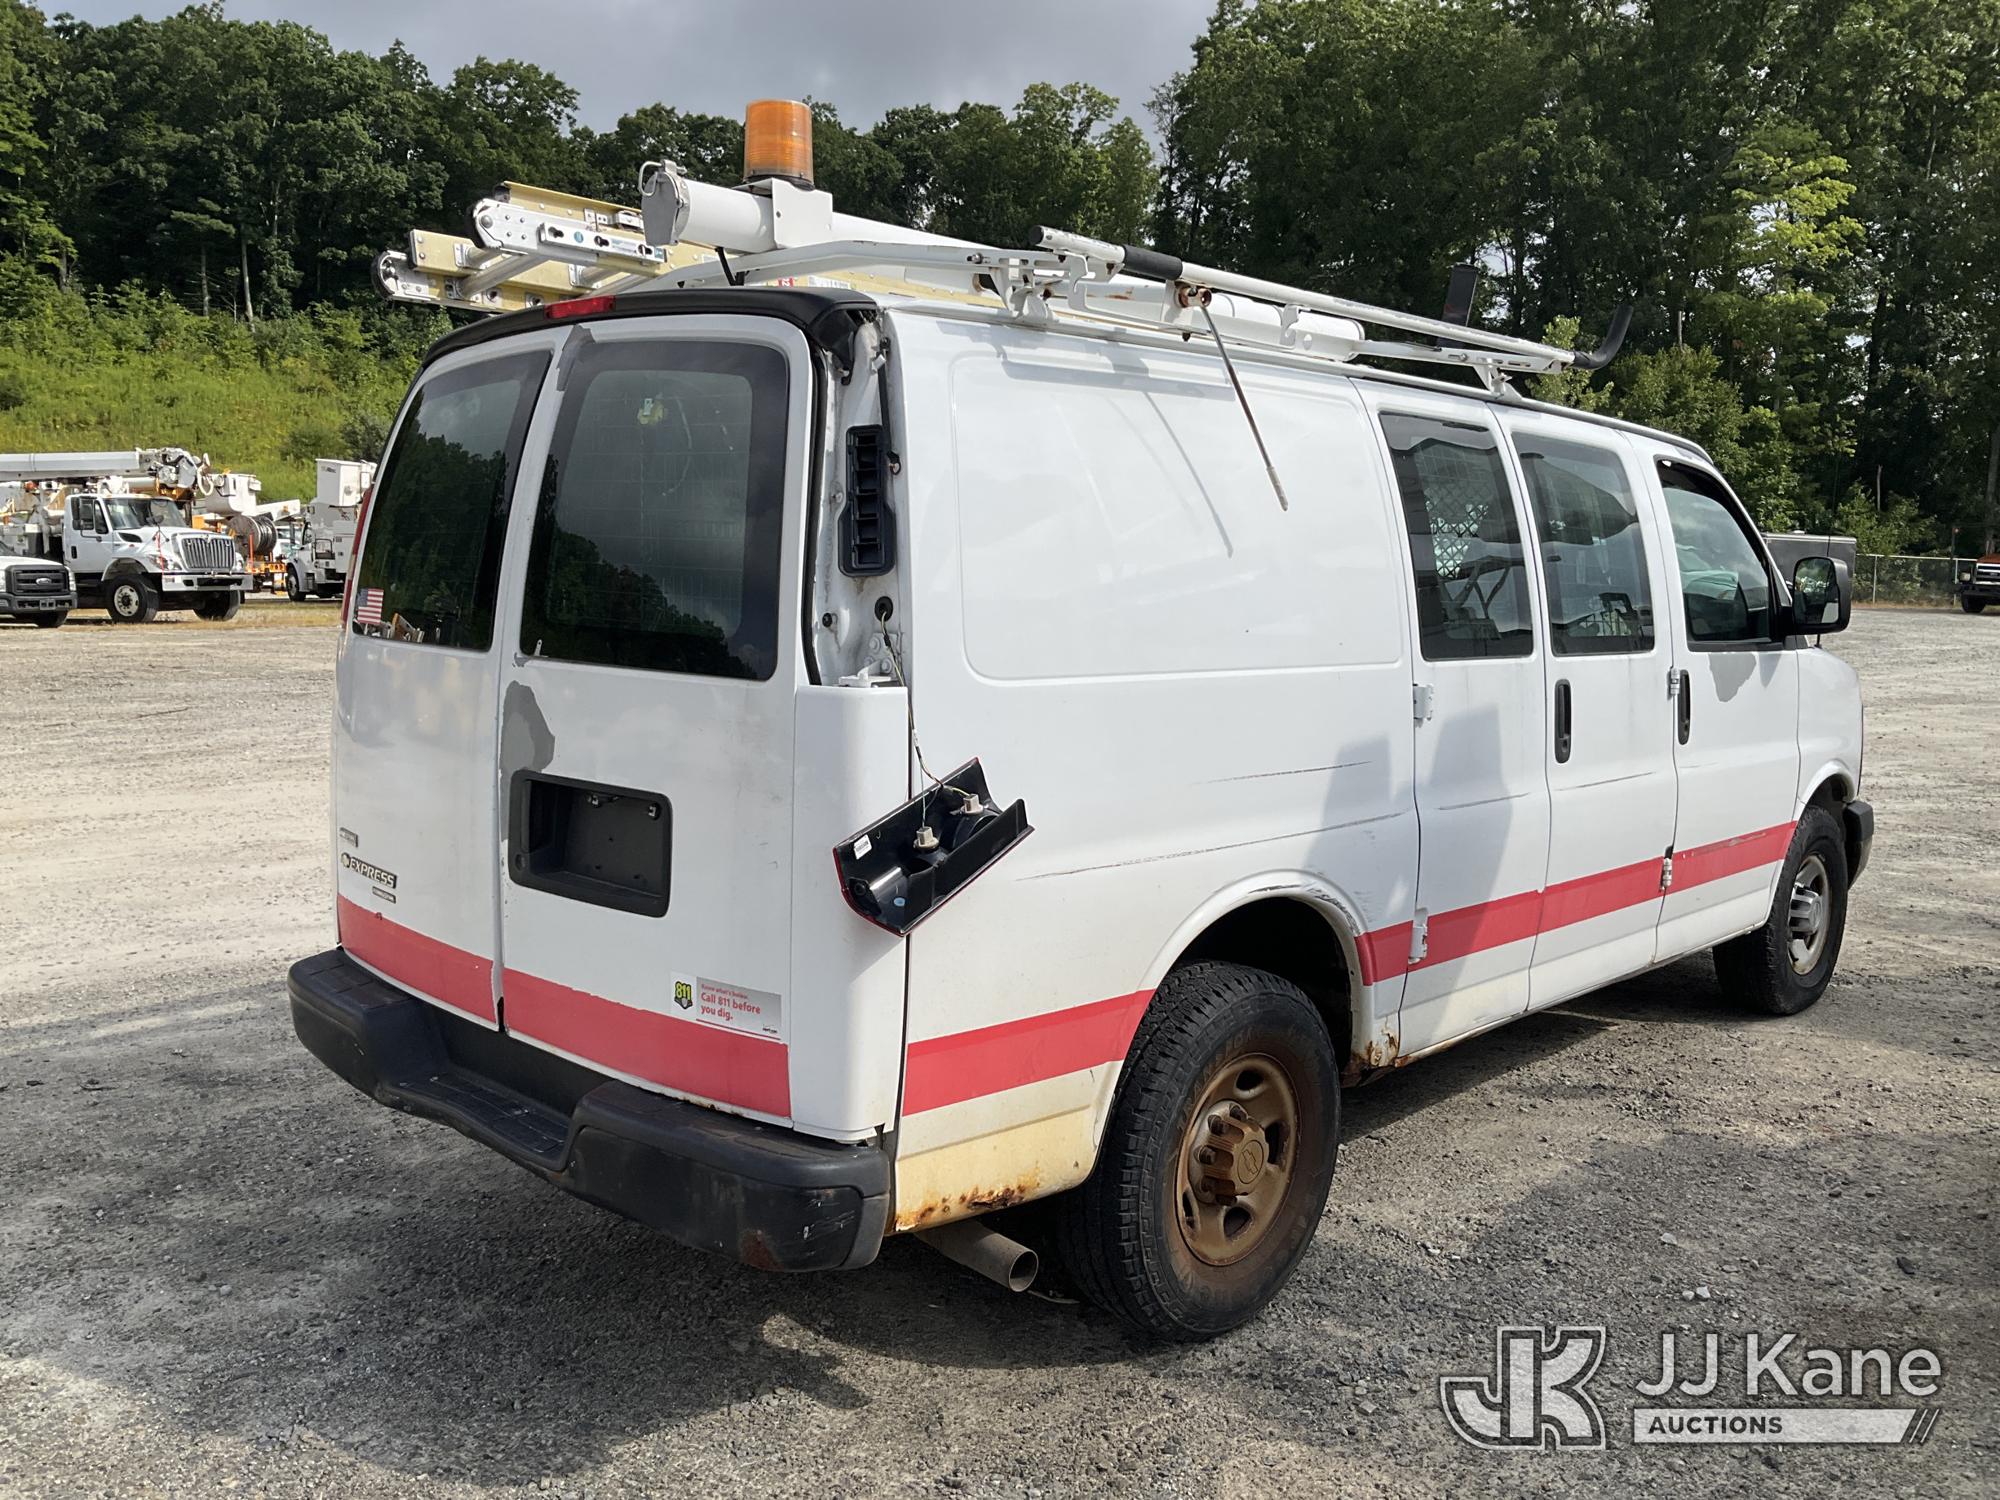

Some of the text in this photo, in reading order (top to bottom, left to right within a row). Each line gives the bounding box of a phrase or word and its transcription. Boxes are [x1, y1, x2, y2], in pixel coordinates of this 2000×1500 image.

[350, 858, 395, 888] EXPRESS
[675, 981, 692, 1001] 811
[701, 992, 761, 1014] Call 811 before
[701, 1005, 733, 1020] you dig.
